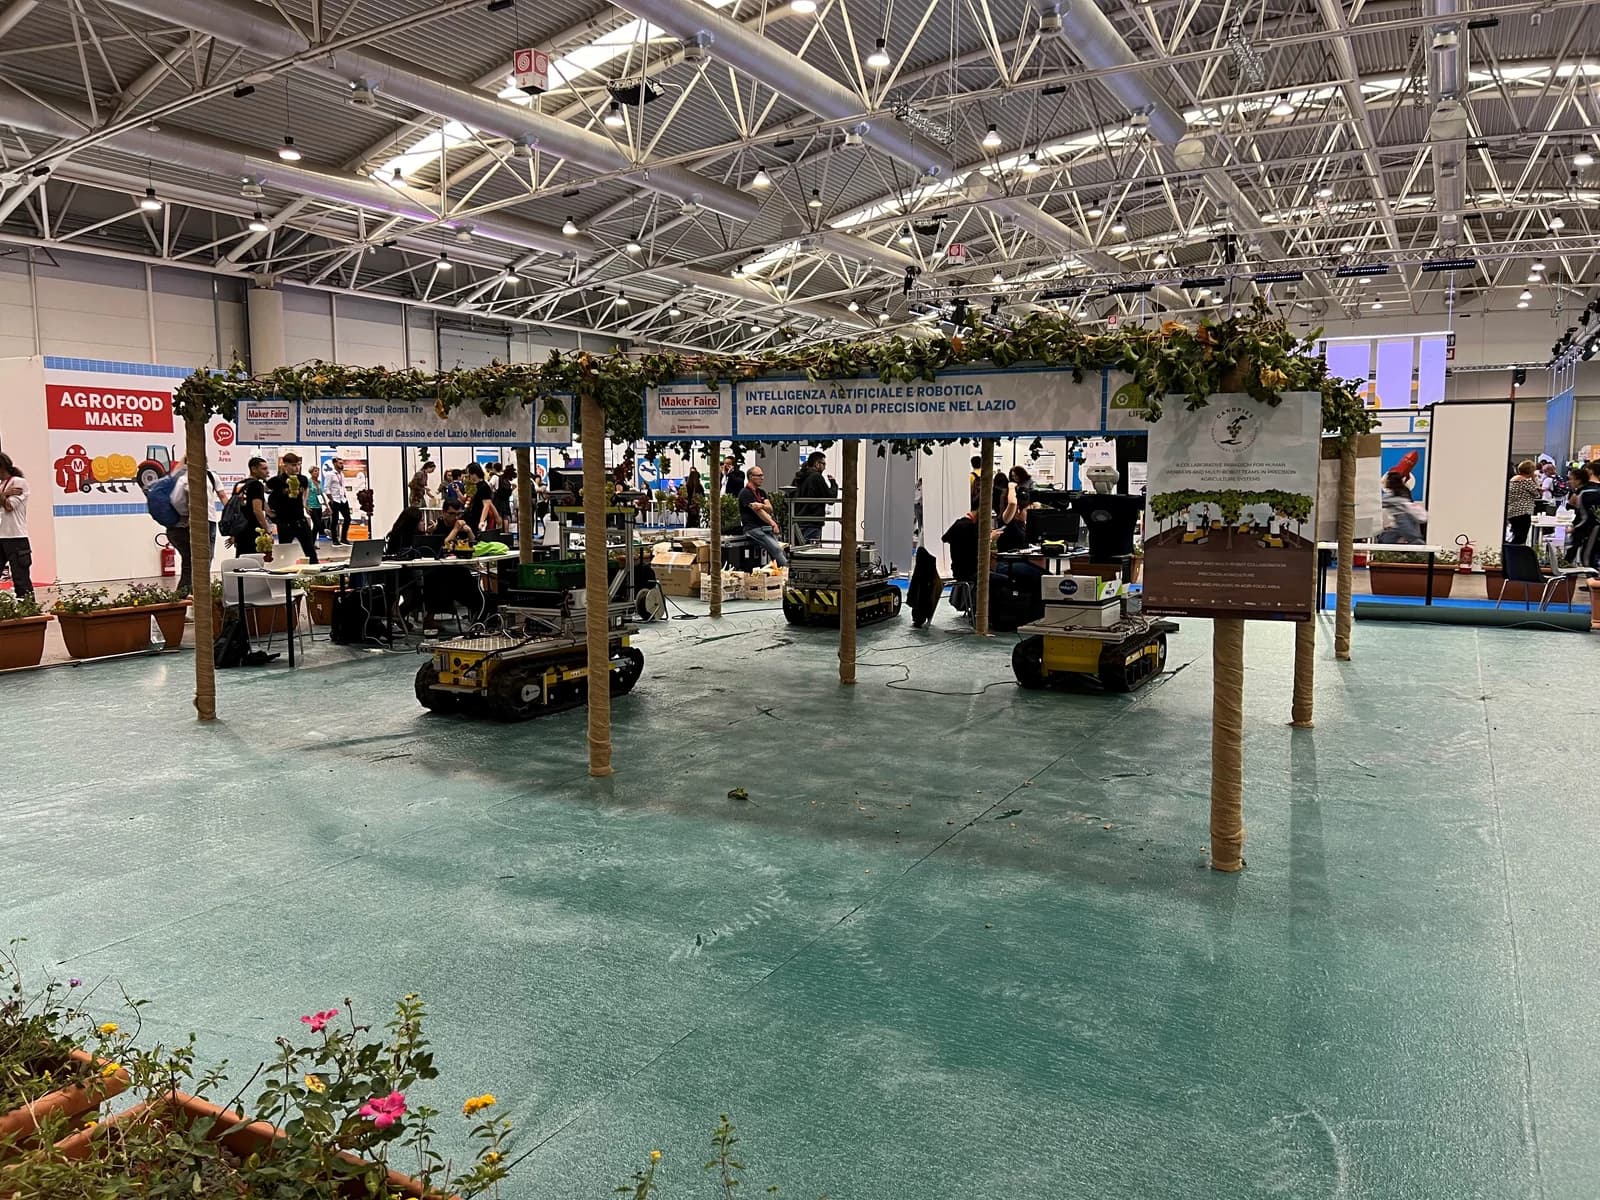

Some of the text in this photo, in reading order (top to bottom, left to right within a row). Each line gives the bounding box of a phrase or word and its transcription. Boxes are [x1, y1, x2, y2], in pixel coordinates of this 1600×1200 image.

[746, 390, 825, 401] INTELLIGENZA
[906, 386, 913, 396] E
[917, 384, 983, 397] ROBOTICA
[60, 391, 163, 412] AGROFOOD
[661, 396, 718, 406] Maker Faire
[248, 409, 287, 418] Maker Faire
[306, 405, 342, 414] Università
[344, 406, 363, 416] degli
[364, 404, 385, 414] Studi
[386, 406, 408, 414] Roma
[746, 400, 1016, 415] PER AGRICOLTURA DI PRECISIONE NEL LAZIO
[85, 411, 144, 427] MAKER
[306, 418, 342, 426] Università
[345, 418, 352, 426] di
[306, 428, 342, 438] Università
[344, 429, 363, 440] degli
[364, 429, 384, 438] Studi
[386, 430, 394, 438] di
[395, 430, 425, 438] Cassino
[434, 429, 446, 438] del
[447, 429, 468, 438] Lazio
[470, 429, 517, 438] Meridionale
[73, 460, 83, 470] M
